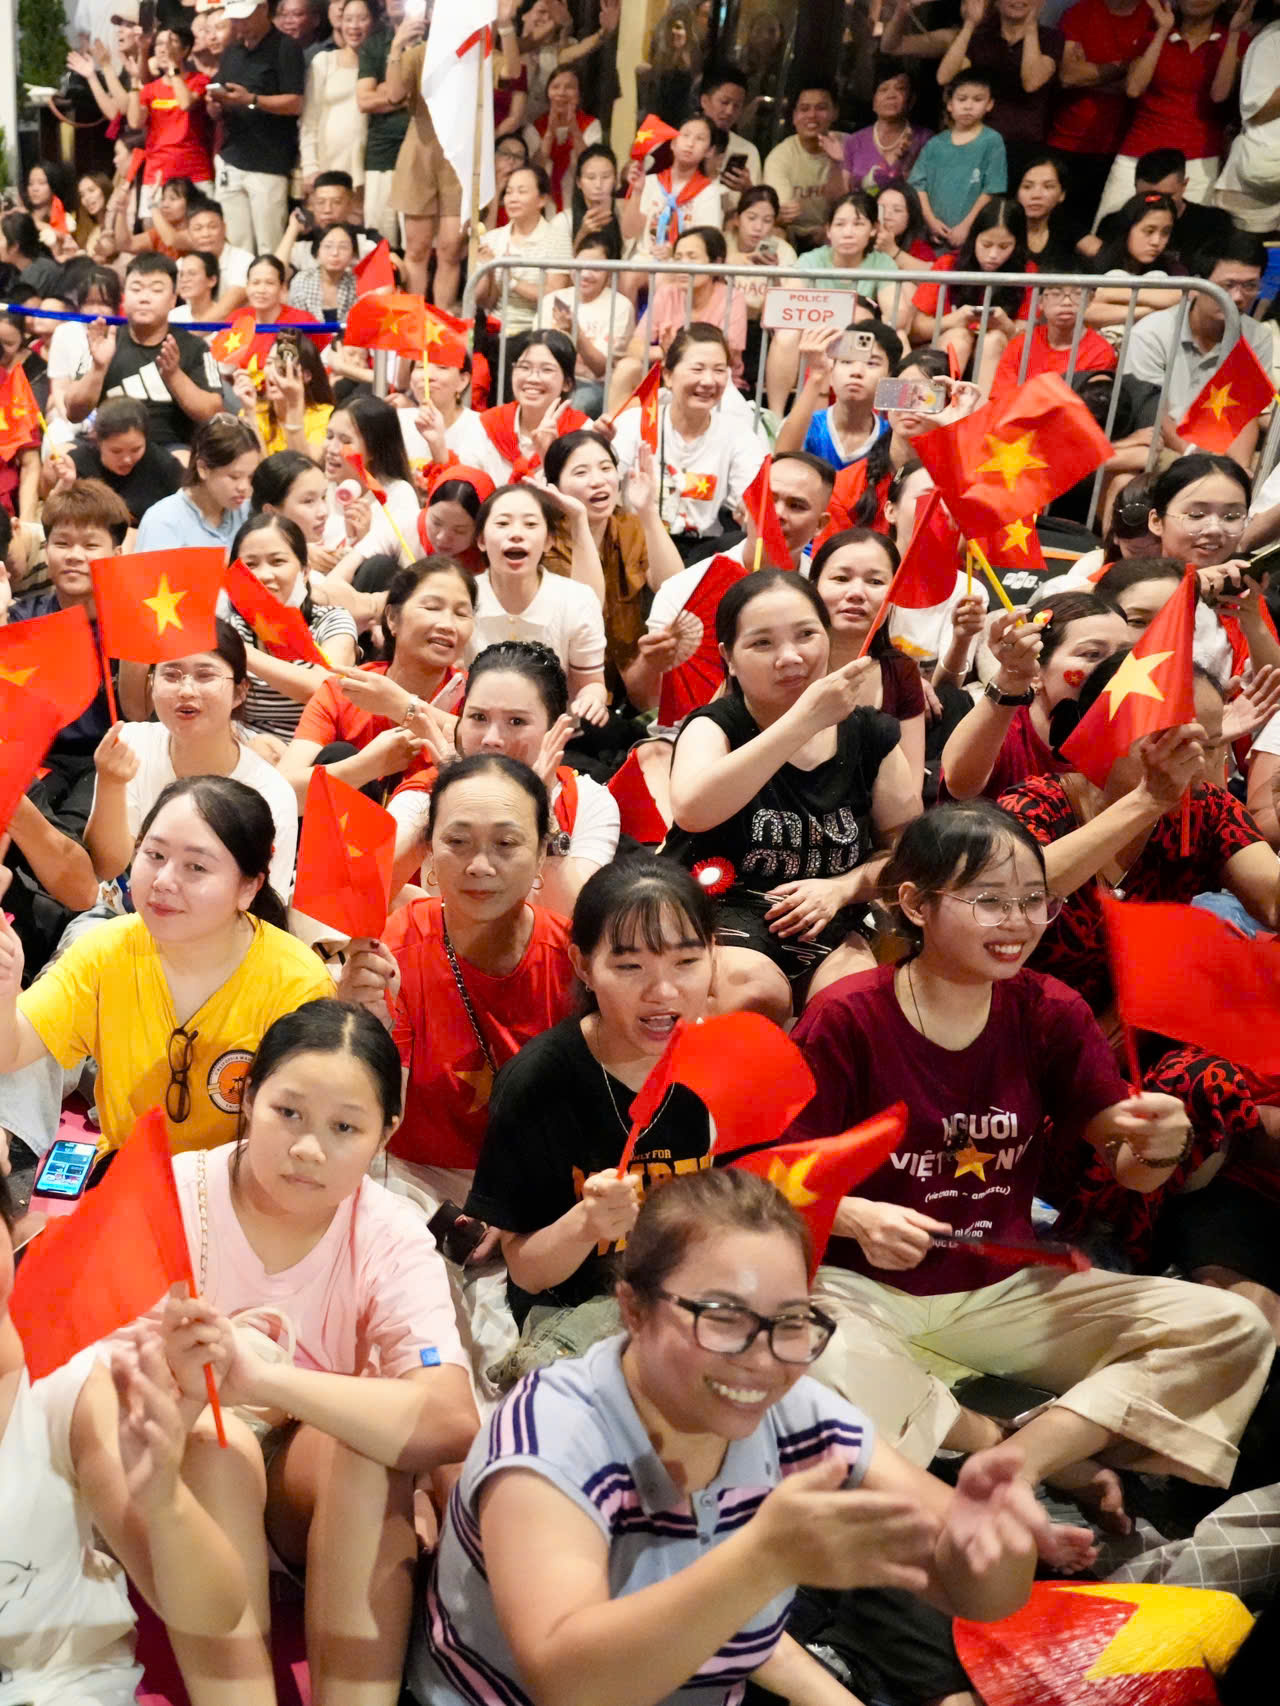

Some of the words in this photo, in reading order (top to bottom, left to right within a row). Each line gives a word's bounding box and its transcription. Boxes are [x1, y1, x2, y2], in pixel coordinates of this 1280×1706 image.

[790, 293, 829, 303] POLICE
[782, 307, 834, 323] STOP
[652, 1149, 672, 1160] FOR
